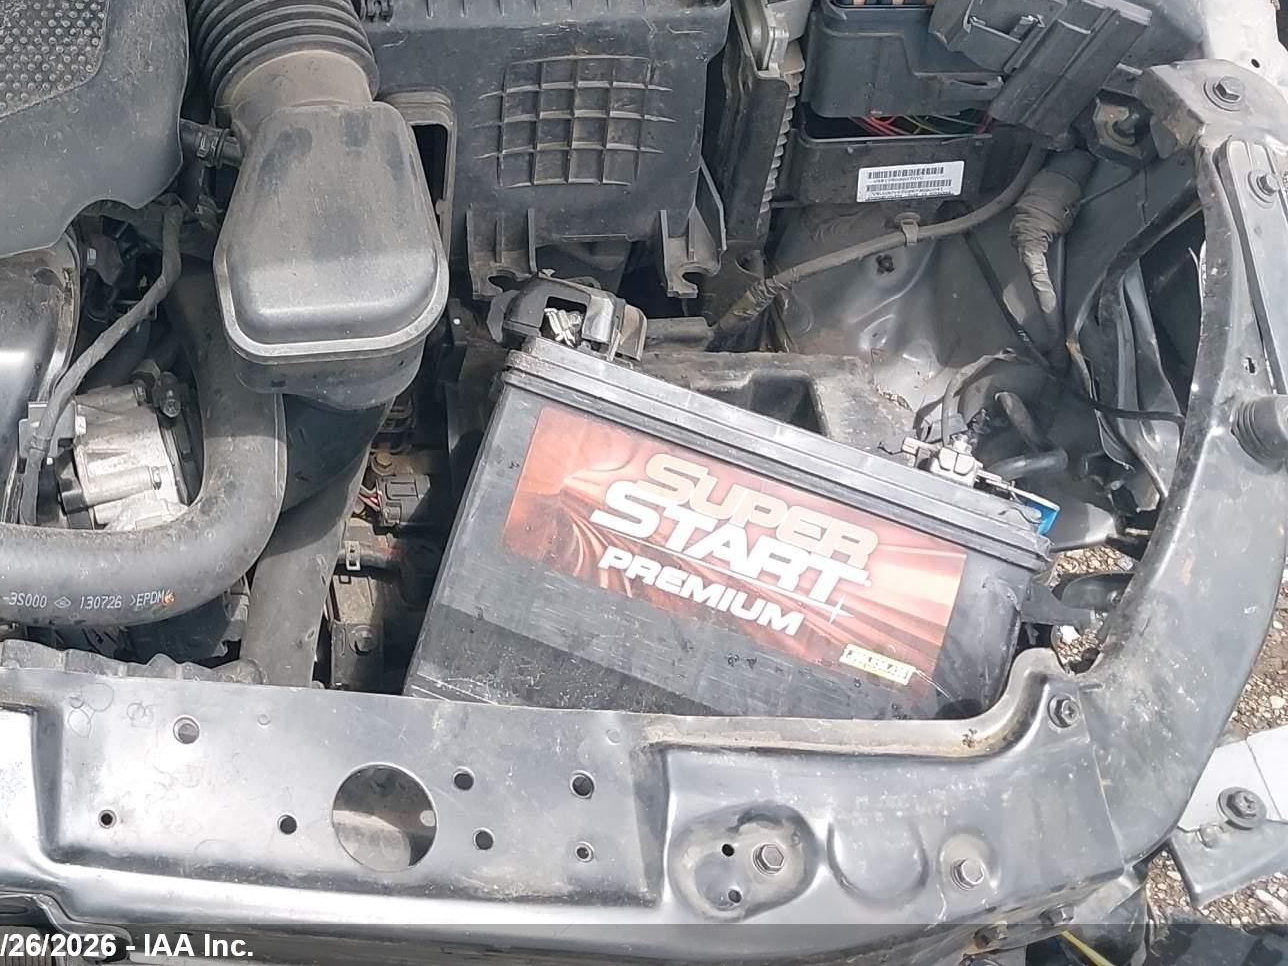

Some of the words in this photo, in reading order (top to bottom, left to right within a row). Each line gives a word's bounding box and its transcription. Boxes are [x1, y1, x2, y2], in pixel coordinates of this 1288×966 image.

[590, 480, 871, 603] START
[645, 453, 878, 570] SUPER
[79, 595, 122, 610] 130726
[598, 545, 805, 635] PREMIUM
